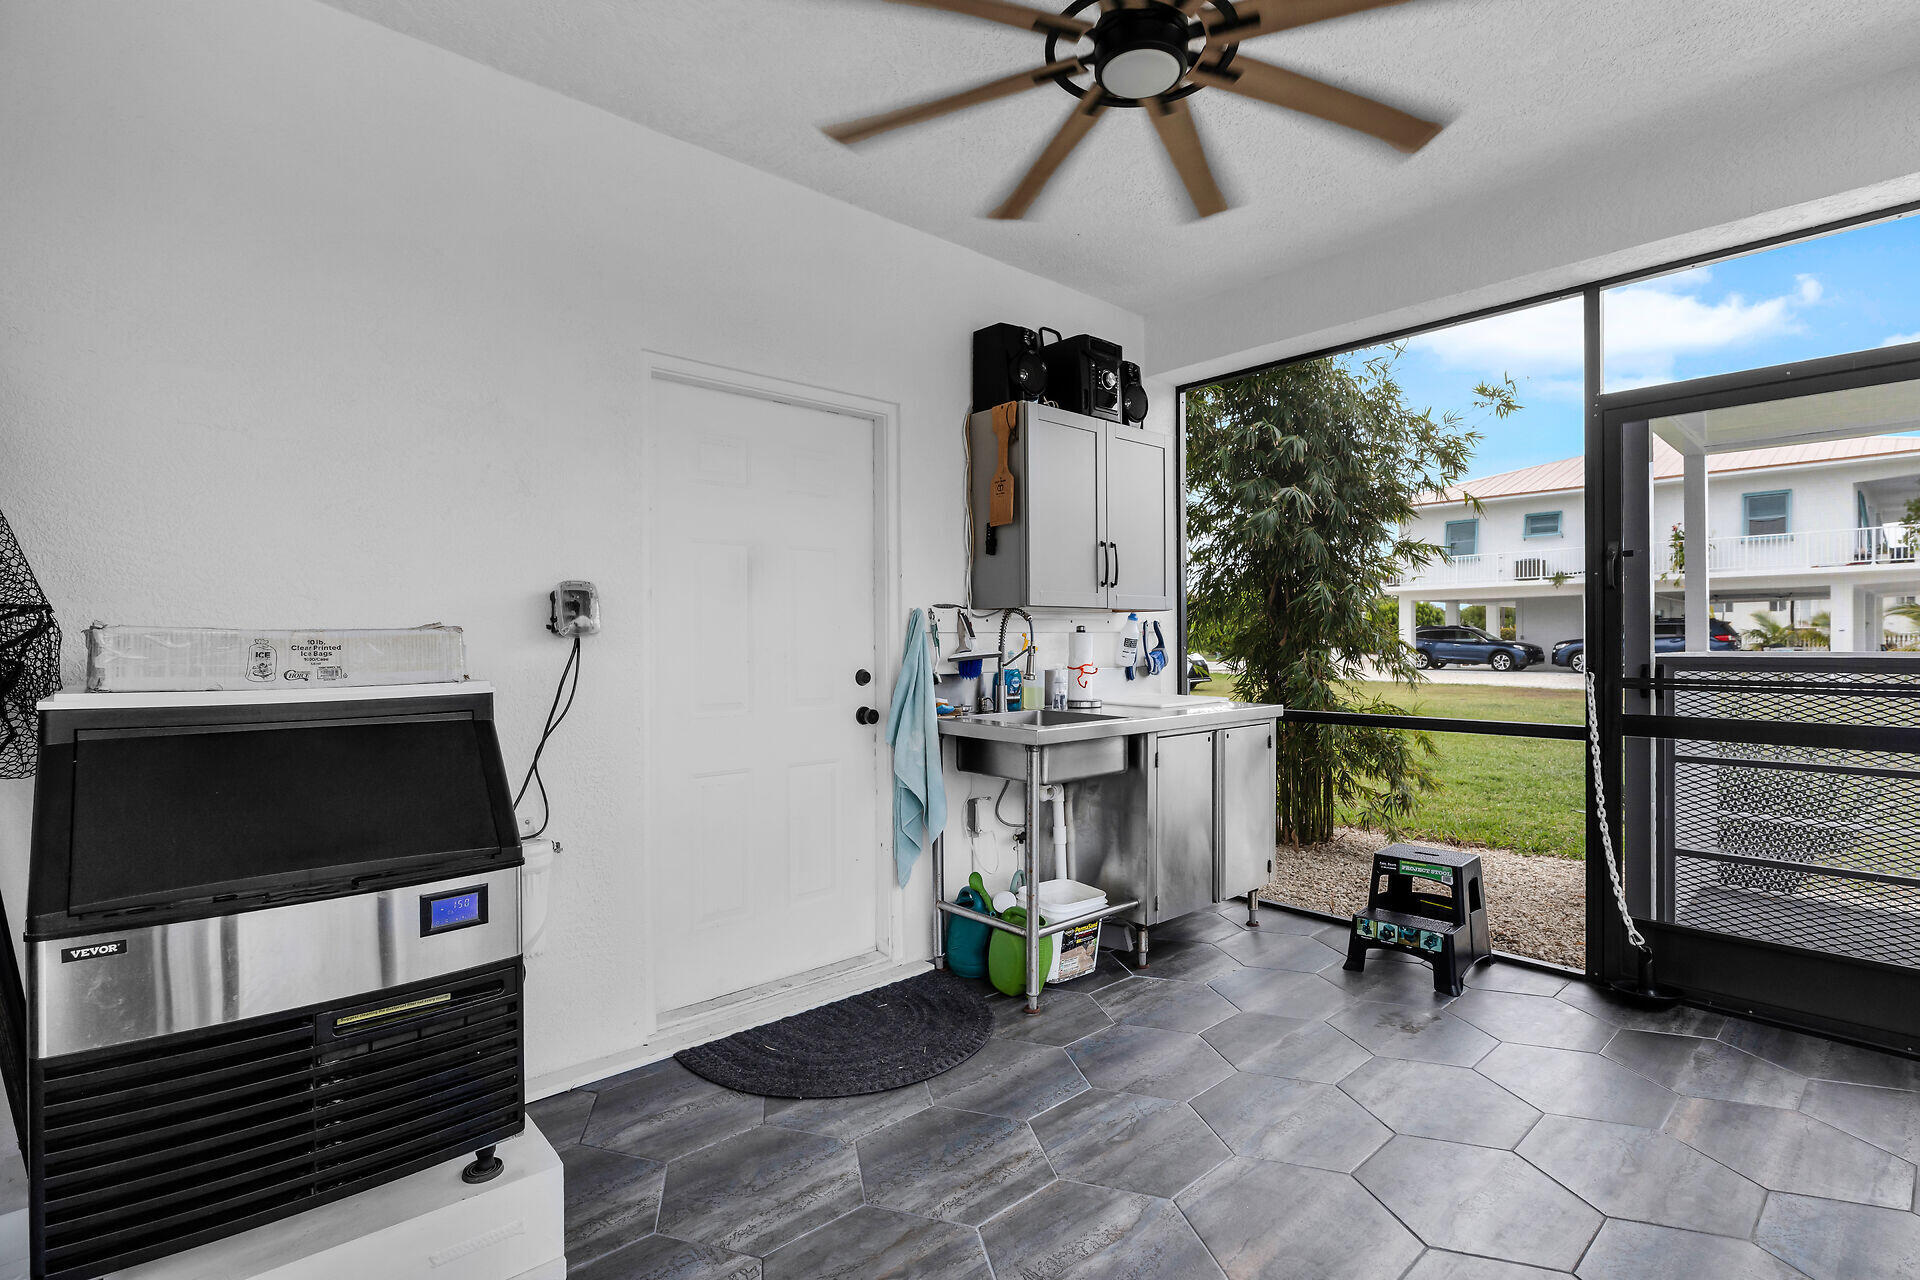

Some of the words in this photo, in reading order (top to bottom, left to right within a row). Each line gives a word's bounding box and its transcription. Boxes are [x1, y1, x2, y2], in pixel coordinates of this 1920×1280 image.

[1401, 865, 1430, 874] PROJECT
[1430, 869, 1452, 877] STOOL
[70, 943, 119, 959] VEVOR
